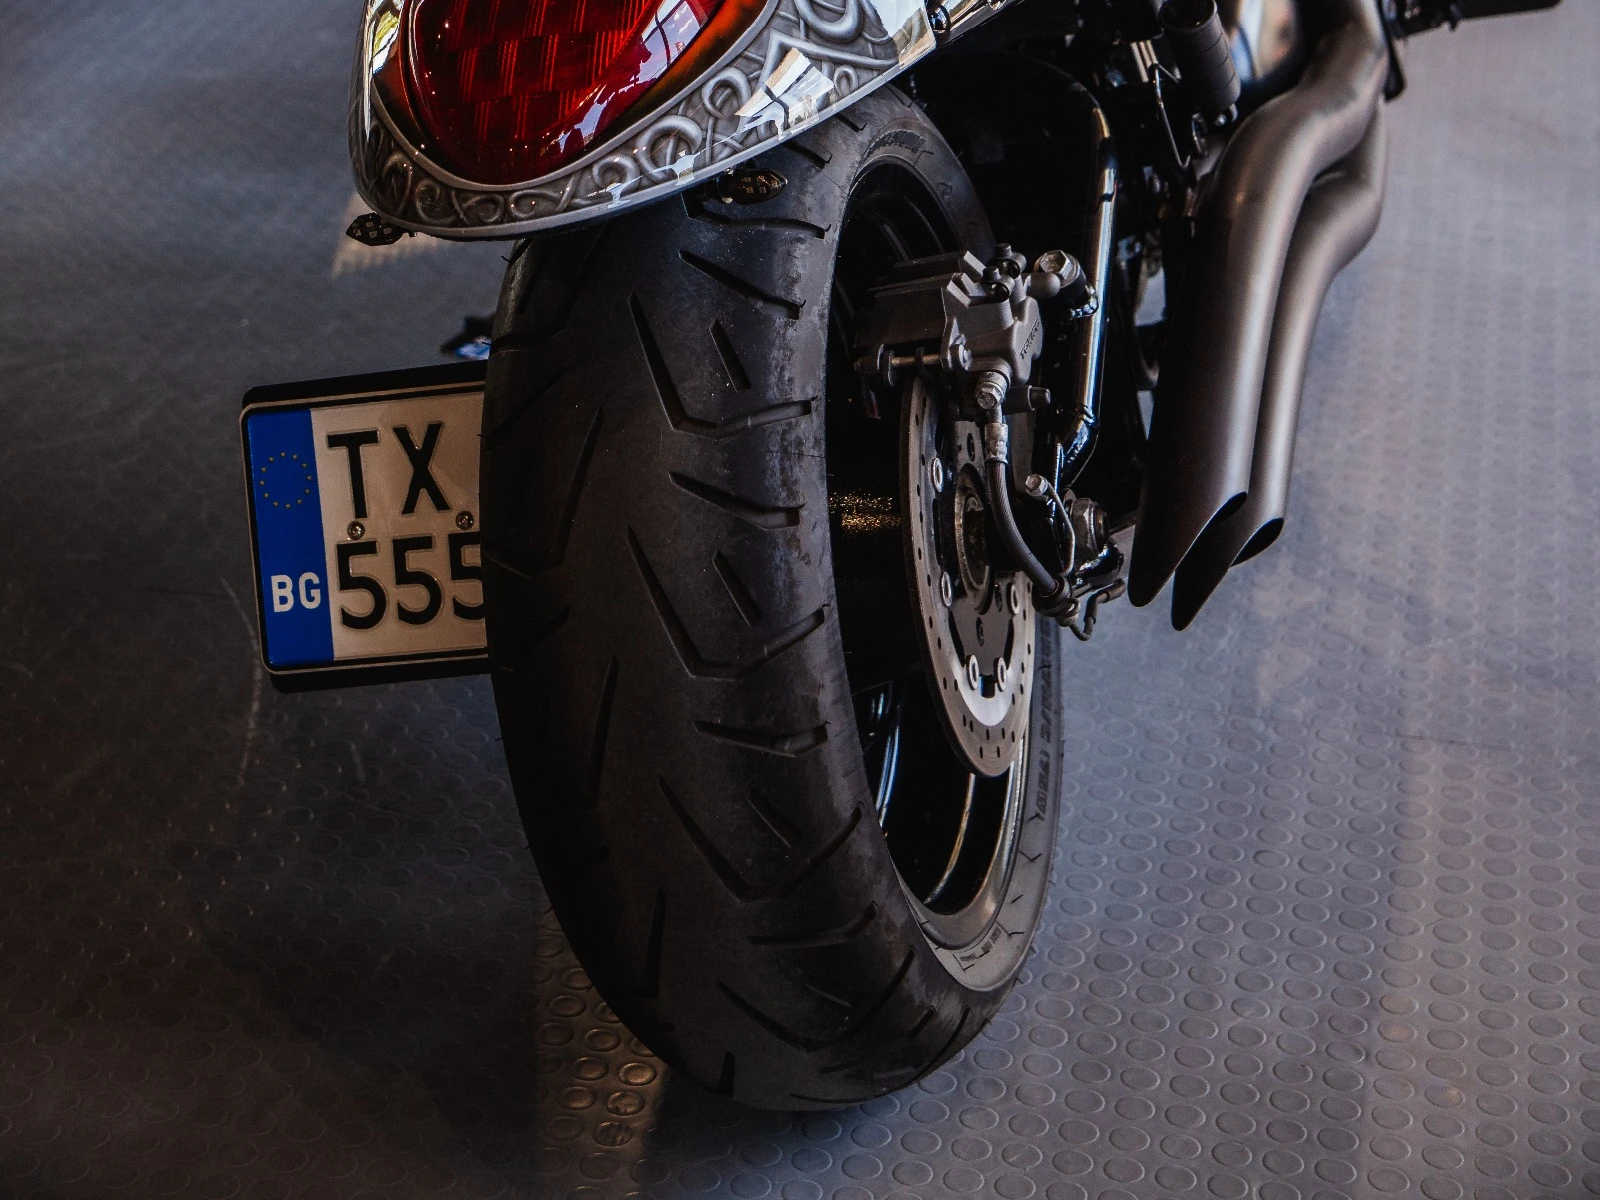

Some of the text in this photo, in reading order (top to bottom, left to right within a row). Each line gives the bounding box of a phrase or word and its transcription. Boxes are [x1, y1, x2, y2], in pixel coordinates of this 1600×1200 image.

[326, 421, 451, 520] TX
[270, 572, 322, 613] BG
[335, 530, 485, 630] 555
